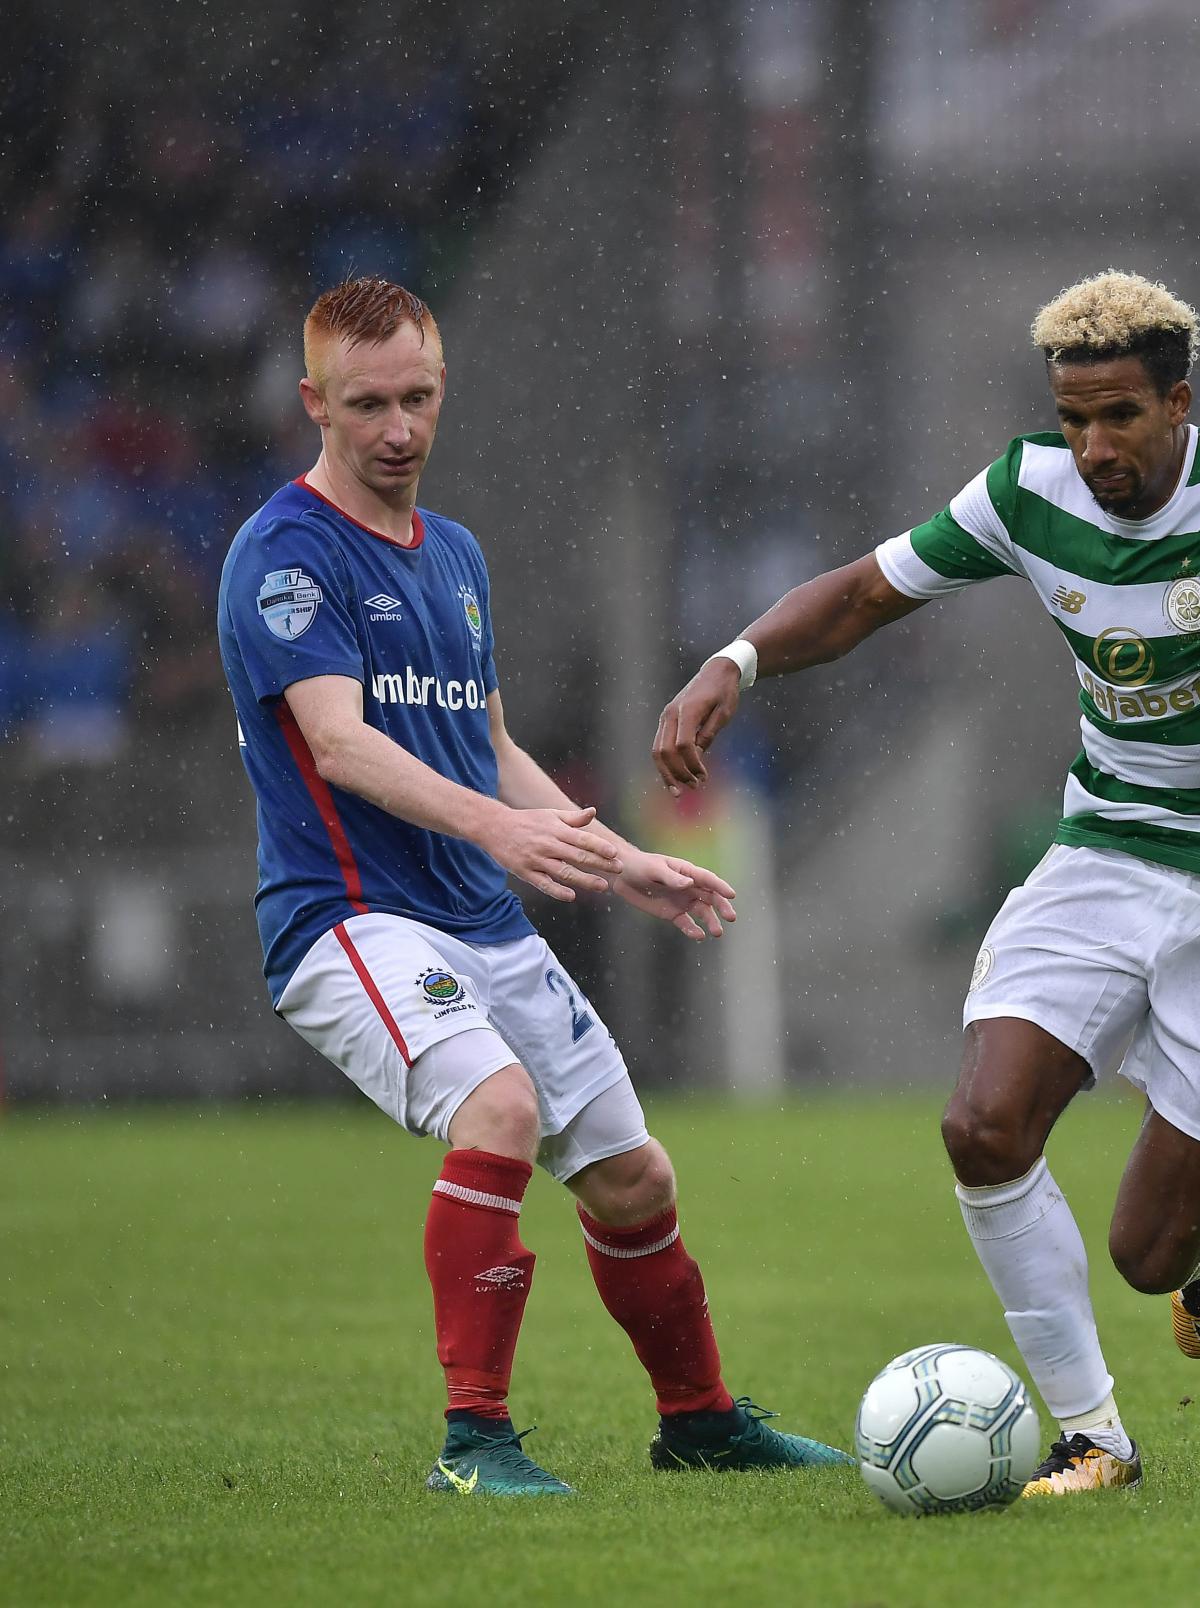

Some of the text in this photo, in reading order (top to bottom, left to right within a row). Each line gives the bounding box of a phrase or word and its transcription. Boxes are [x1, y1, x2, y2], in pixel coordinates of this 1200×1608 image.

[296, 592, 317, 600] Bank
[369, 612, 402, 622] umbro
[433, 1004, 468, 1020] LINFIELD
[545, 968, 594, 1045] 2
